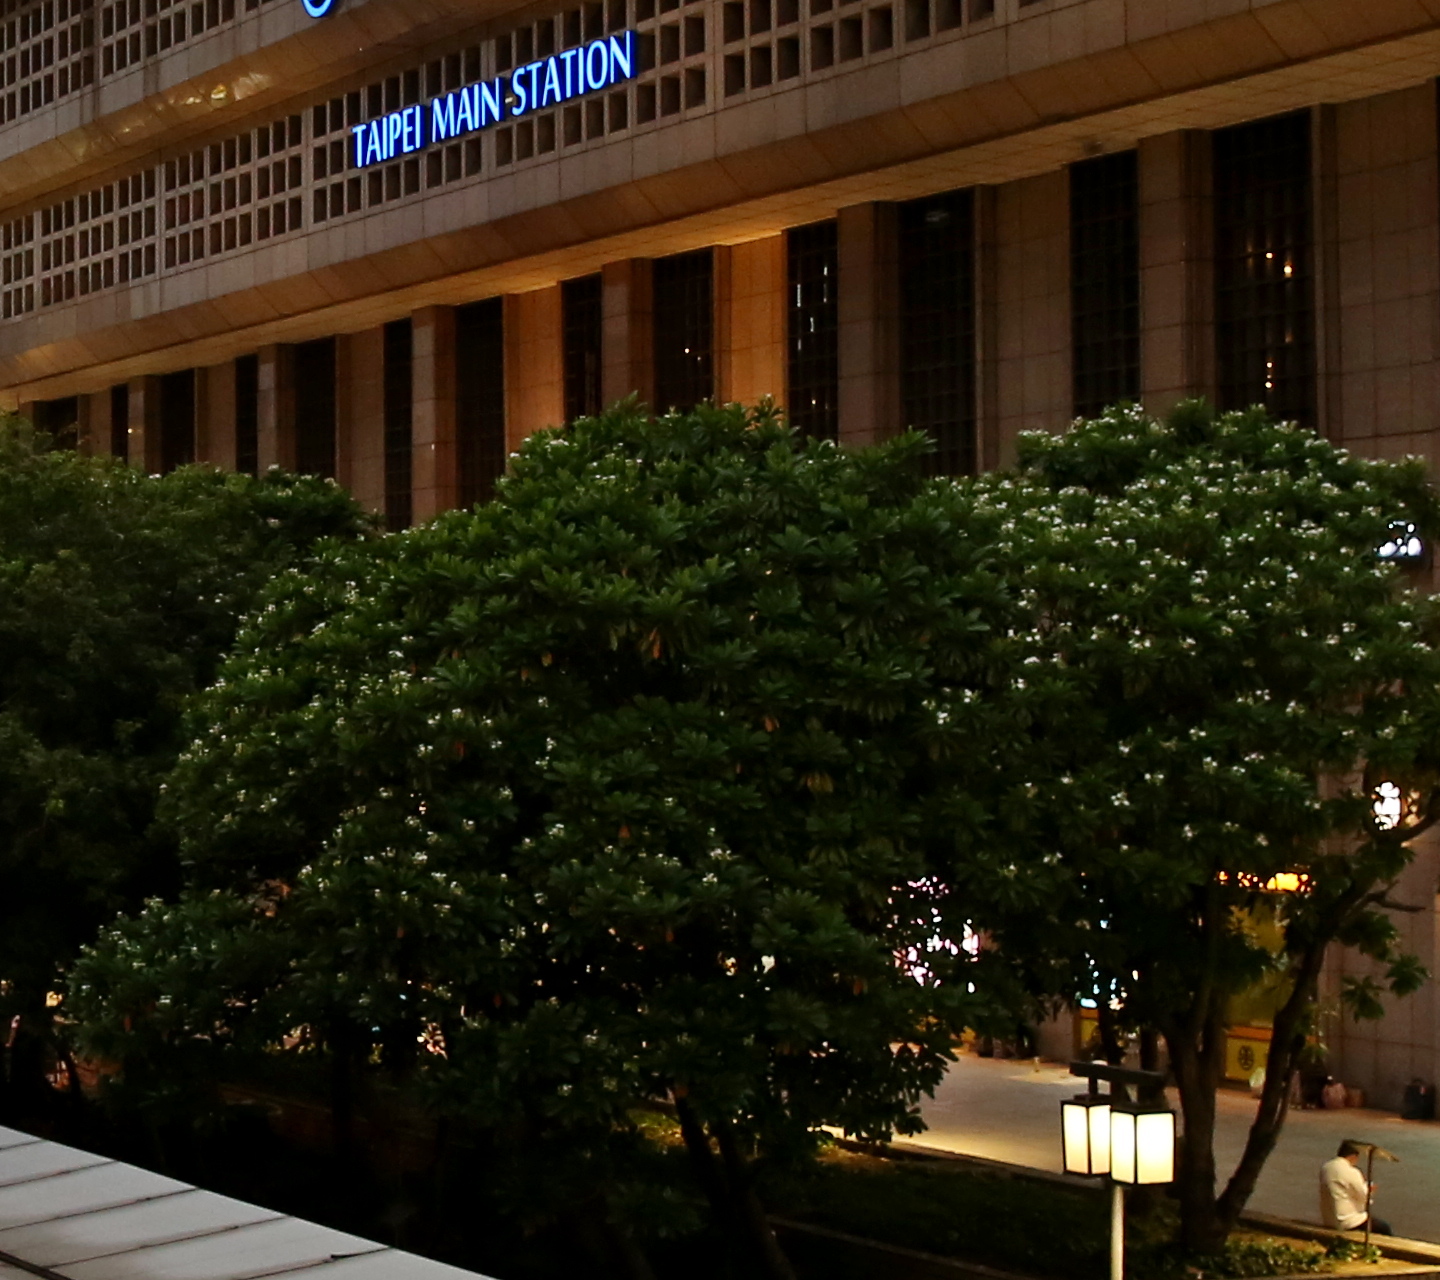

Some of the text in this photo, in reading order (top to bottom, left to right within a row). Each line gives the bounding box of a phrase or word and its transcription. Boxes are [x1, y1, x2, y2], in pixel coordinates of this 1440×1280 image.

[352, 31, 632, 168] TAIPEI MAIN STATION
